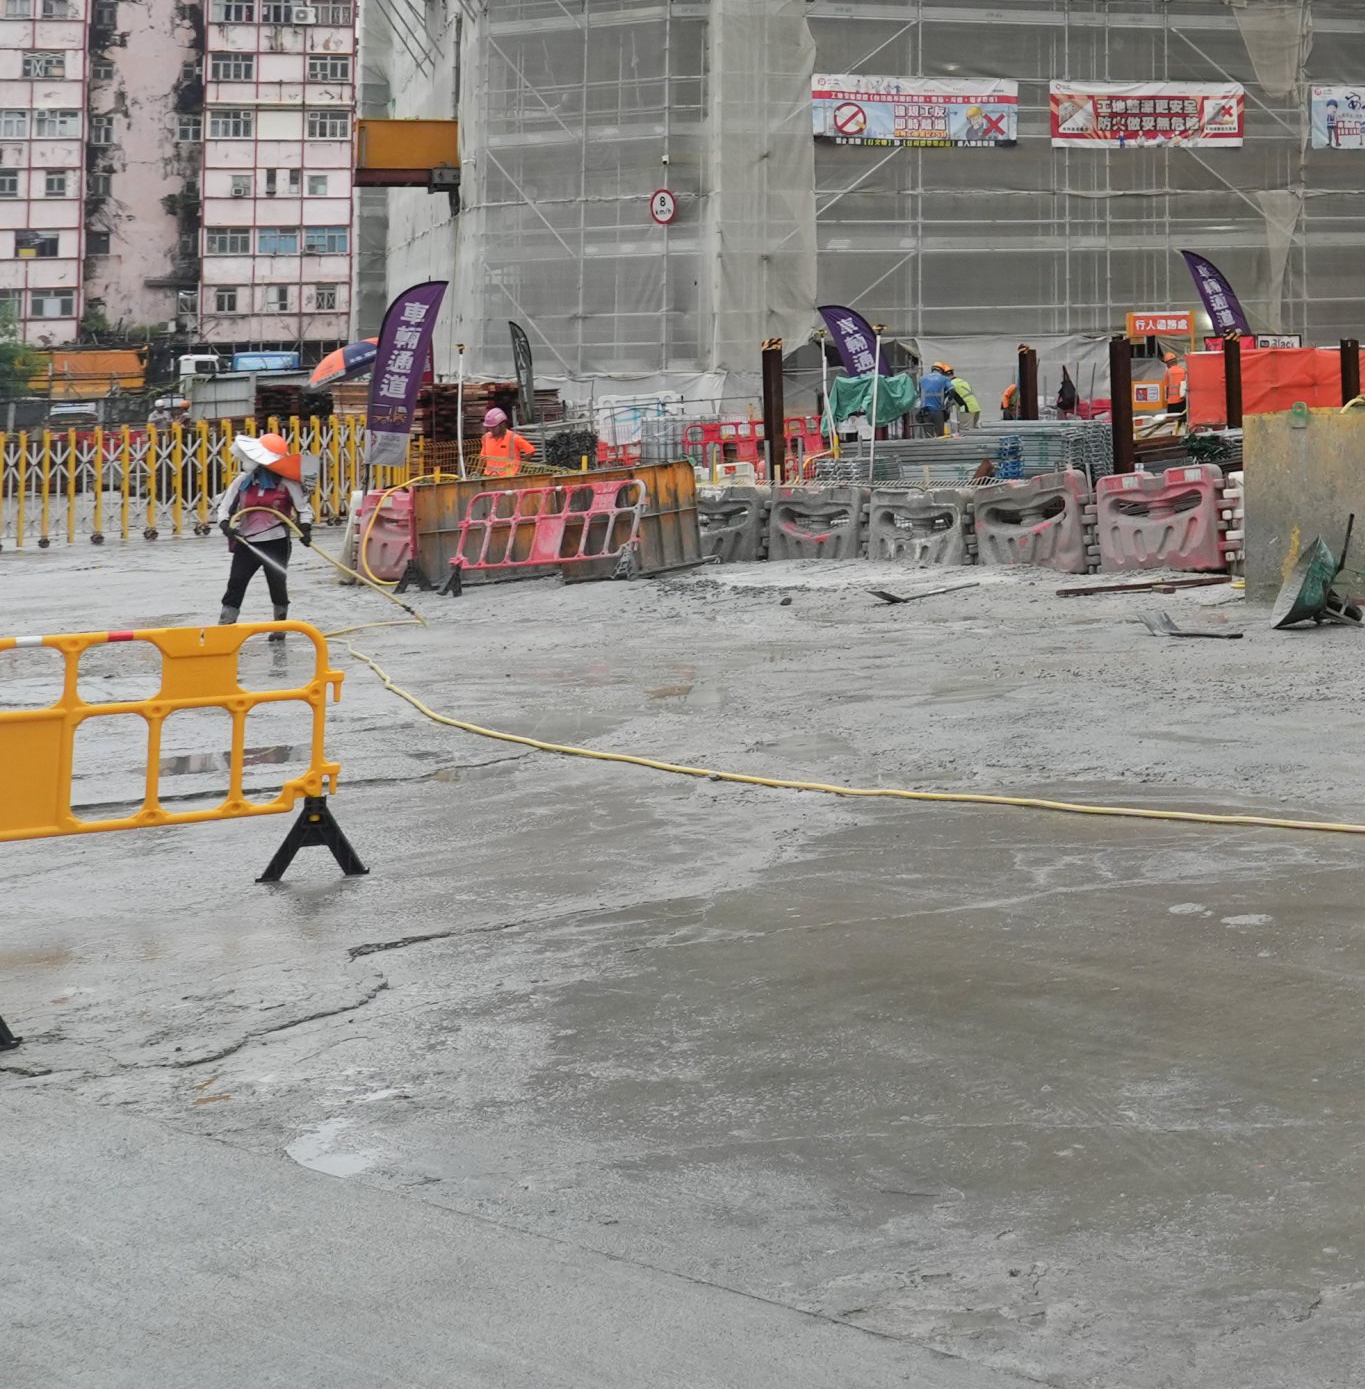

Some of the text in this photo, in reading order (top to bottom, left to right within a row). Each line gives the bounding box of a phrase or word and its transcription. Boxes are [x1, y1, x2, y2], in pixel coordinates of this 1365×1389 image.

[1097, 99, 1198, 114] 工地整潔更安全
[894, 118, 947, 131] 即時離場
[660, 196, 666, 207] 8
[379, 302, 429, 399] 車輛通道
[836, 317, 877, 377] 車輛通
